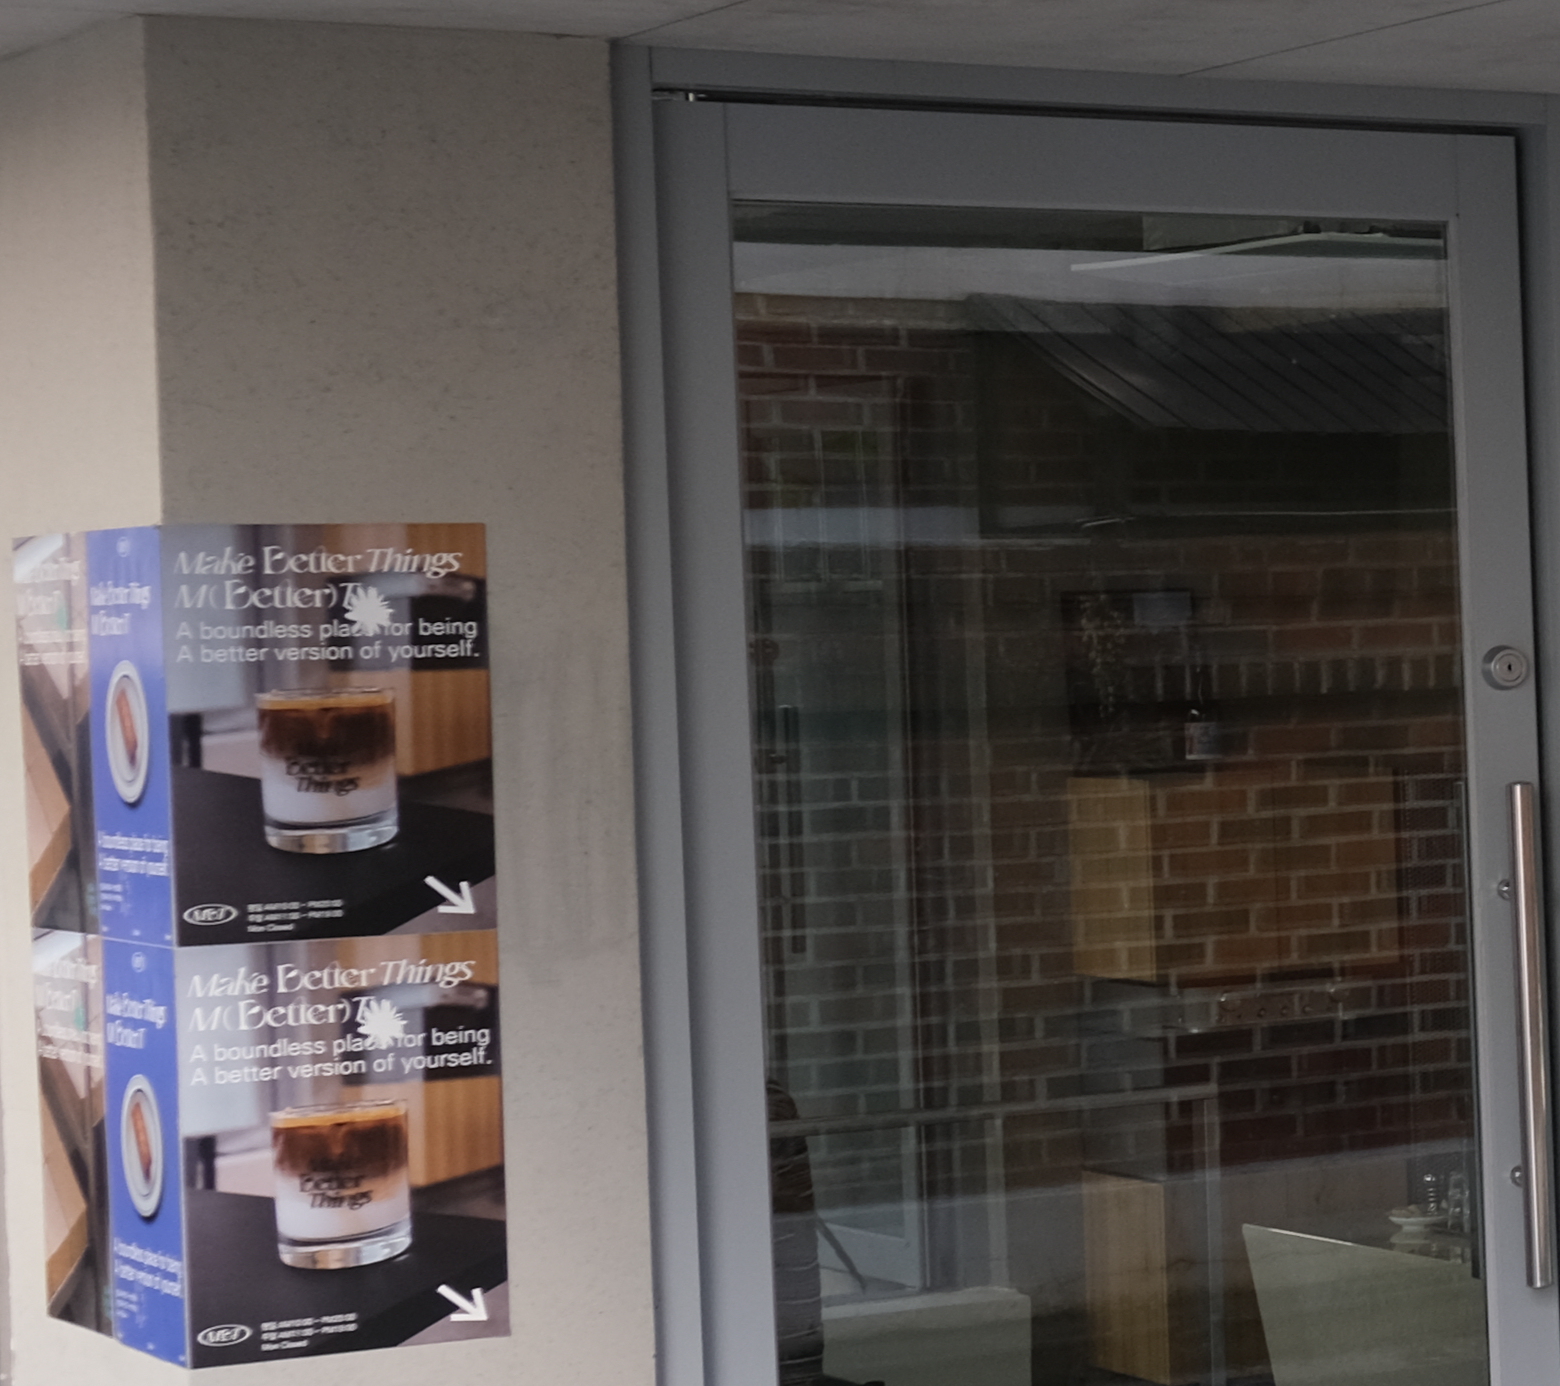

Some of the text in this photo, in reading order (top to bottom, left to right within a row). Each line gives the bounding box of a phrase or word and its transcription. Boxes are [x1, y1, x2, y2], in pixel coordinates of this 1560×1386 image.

[174, 545, 463, 578] Make Better Things
[176, 621, 193, 640] A
[200, 619, 313, 640] boundless
[320, 618, 375, 641] pla
[418, 617, 478, 639] being
[176, 639, 480, 663] A better version of yourself.
[187, 959, 476, 998] Make Better Things
[189, 1045, 206, 1062] A
[213, 1038, 326, 1062] boundless
[333, 1033, 389, 1056] pla
[431, 1026, 490, 1046] being
[190, 1046, 492, 1086] A better version of yourself.
